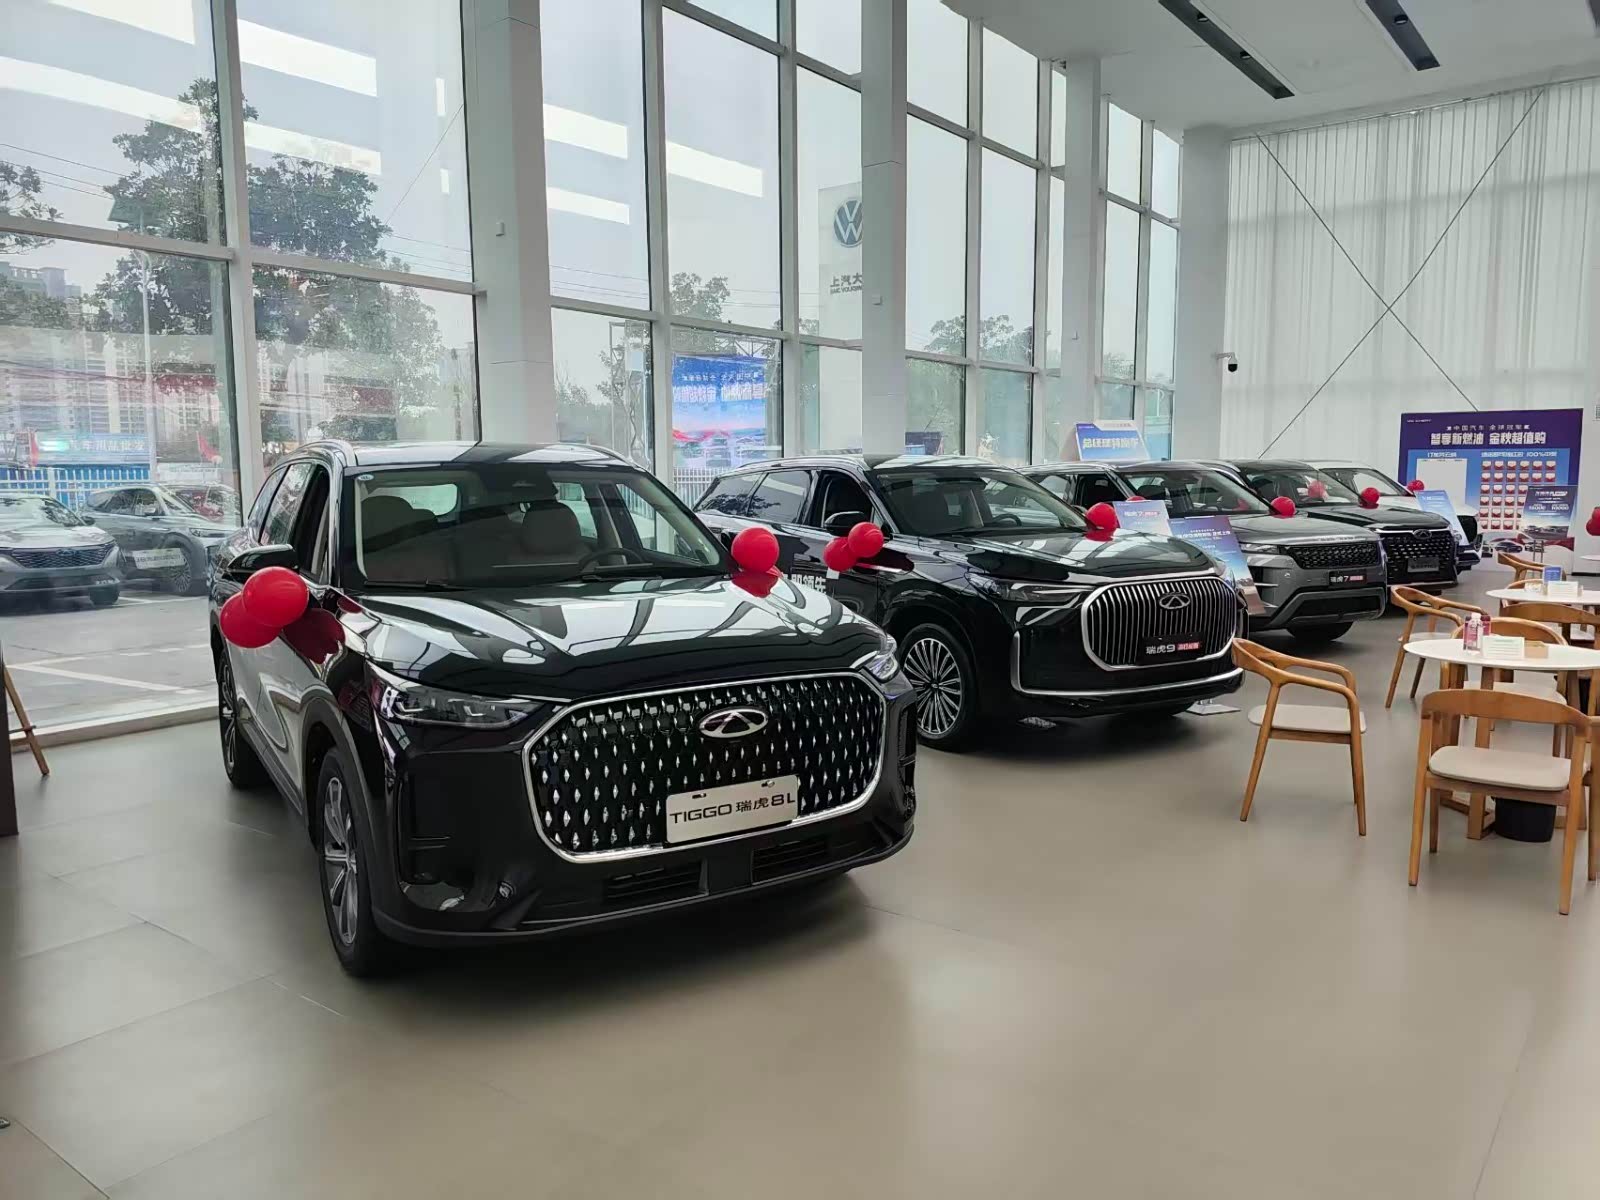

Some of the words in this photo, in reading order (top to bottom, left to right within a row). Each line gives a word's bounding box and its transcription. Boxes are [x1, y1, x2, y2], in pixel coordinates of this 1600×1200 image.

[1489, 431, 1546, 445] 金秋超值购
[1146, 643, 1175, 655] 瑞虎9
[669, 803, 732, 824] TIGGO
[735, 792, 796, 813] 瑞虎8L
